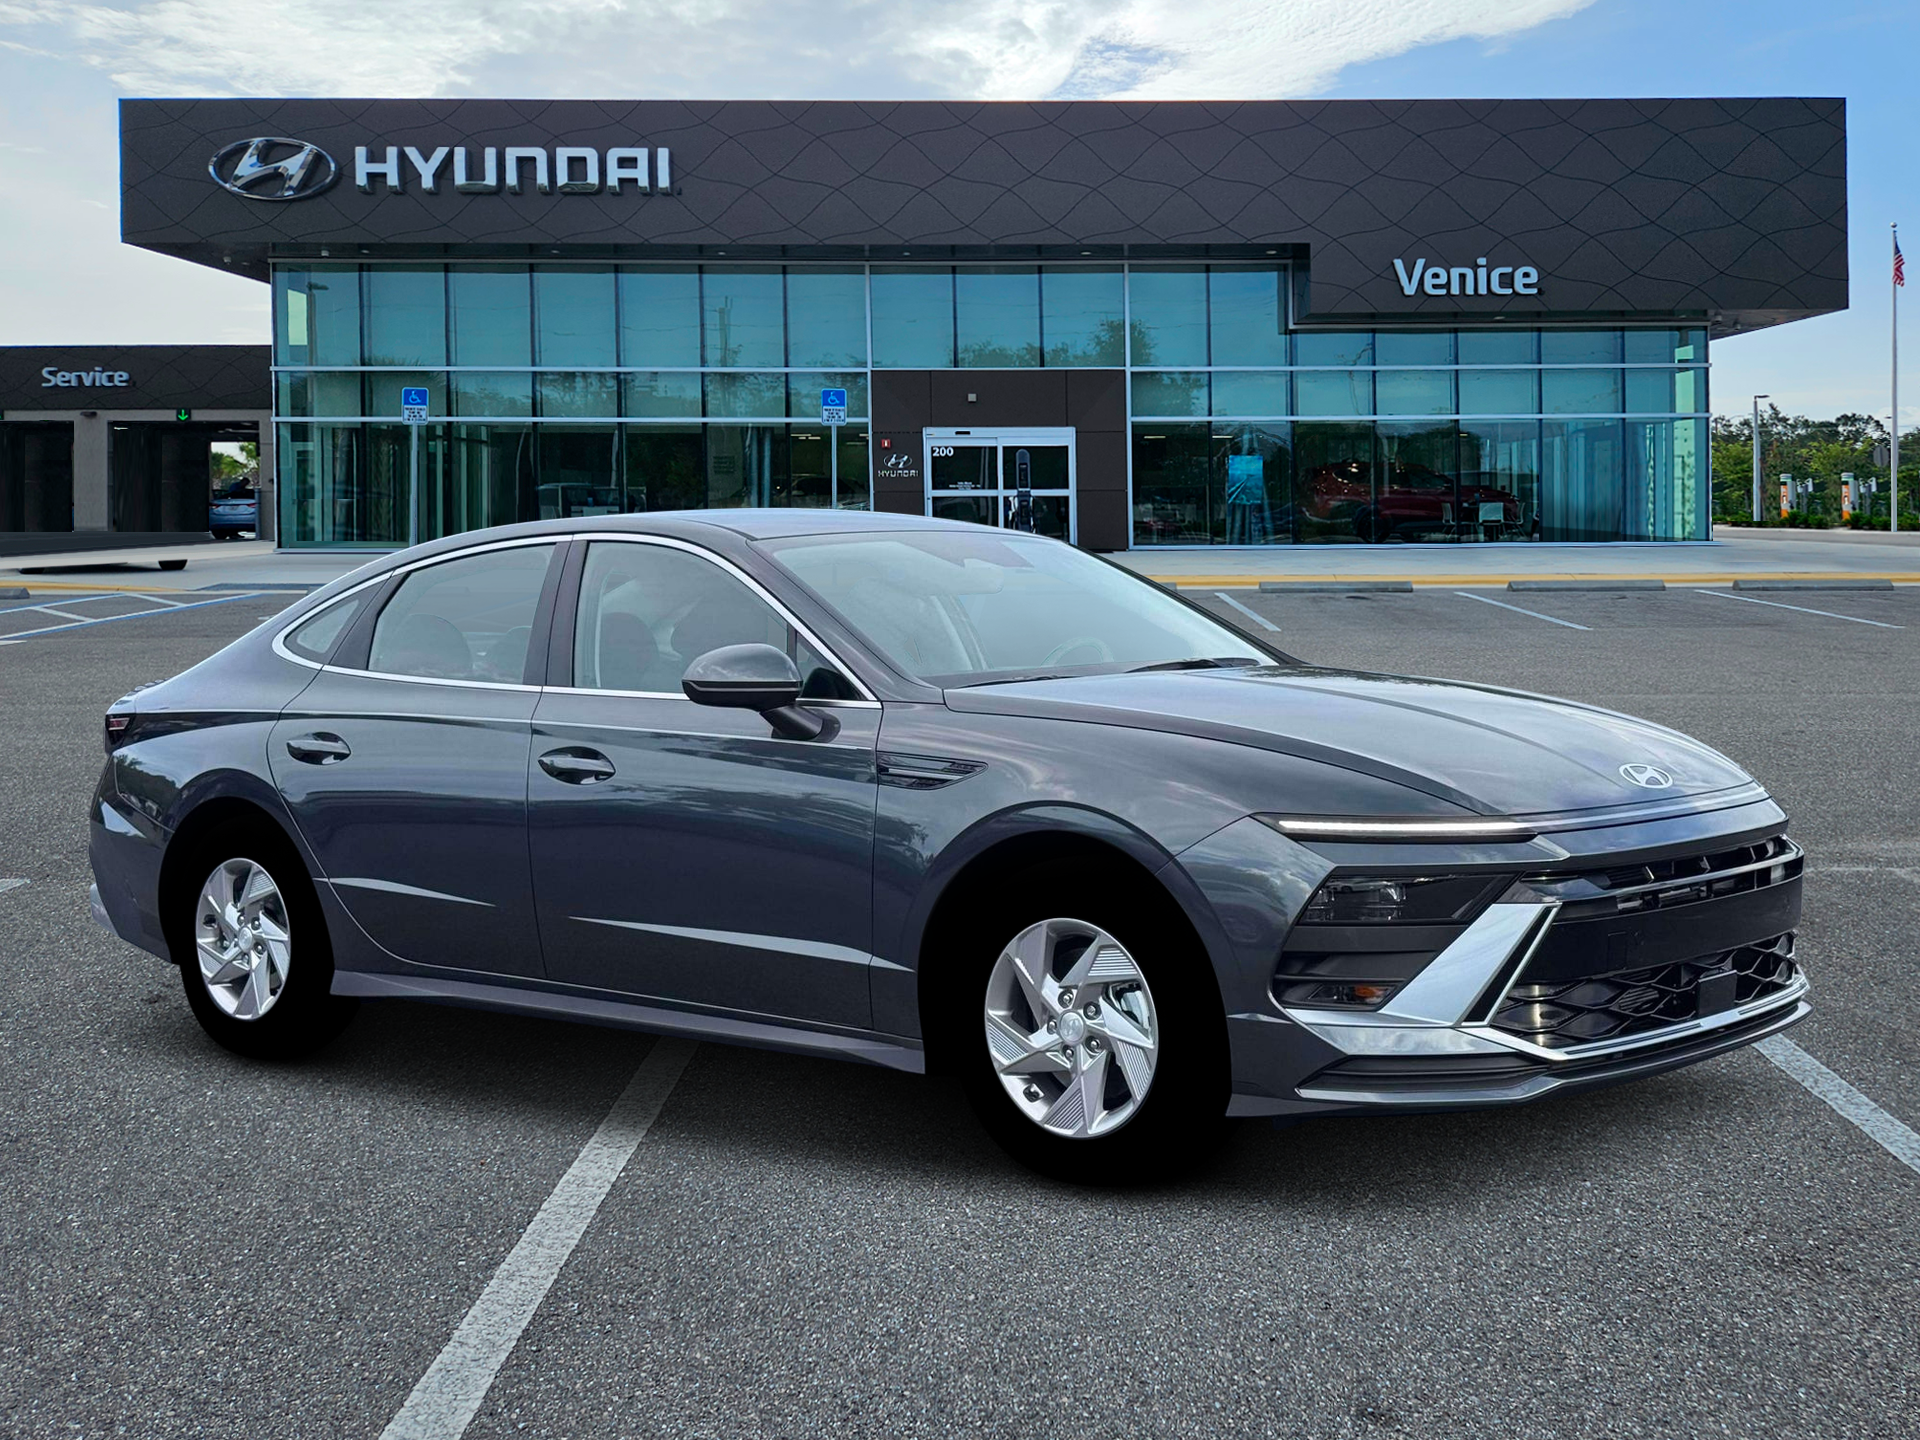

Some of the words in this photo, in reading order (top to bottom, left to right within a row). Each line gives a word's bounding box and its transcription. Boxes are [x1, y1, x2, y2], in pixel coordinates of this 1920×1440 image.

[355, 146, 672, 195] HYUNDAI
[1393, 257, 1539, 296] Venice
[41, 366, 130, 387] Service
[932, 447, 954, 457] 200
